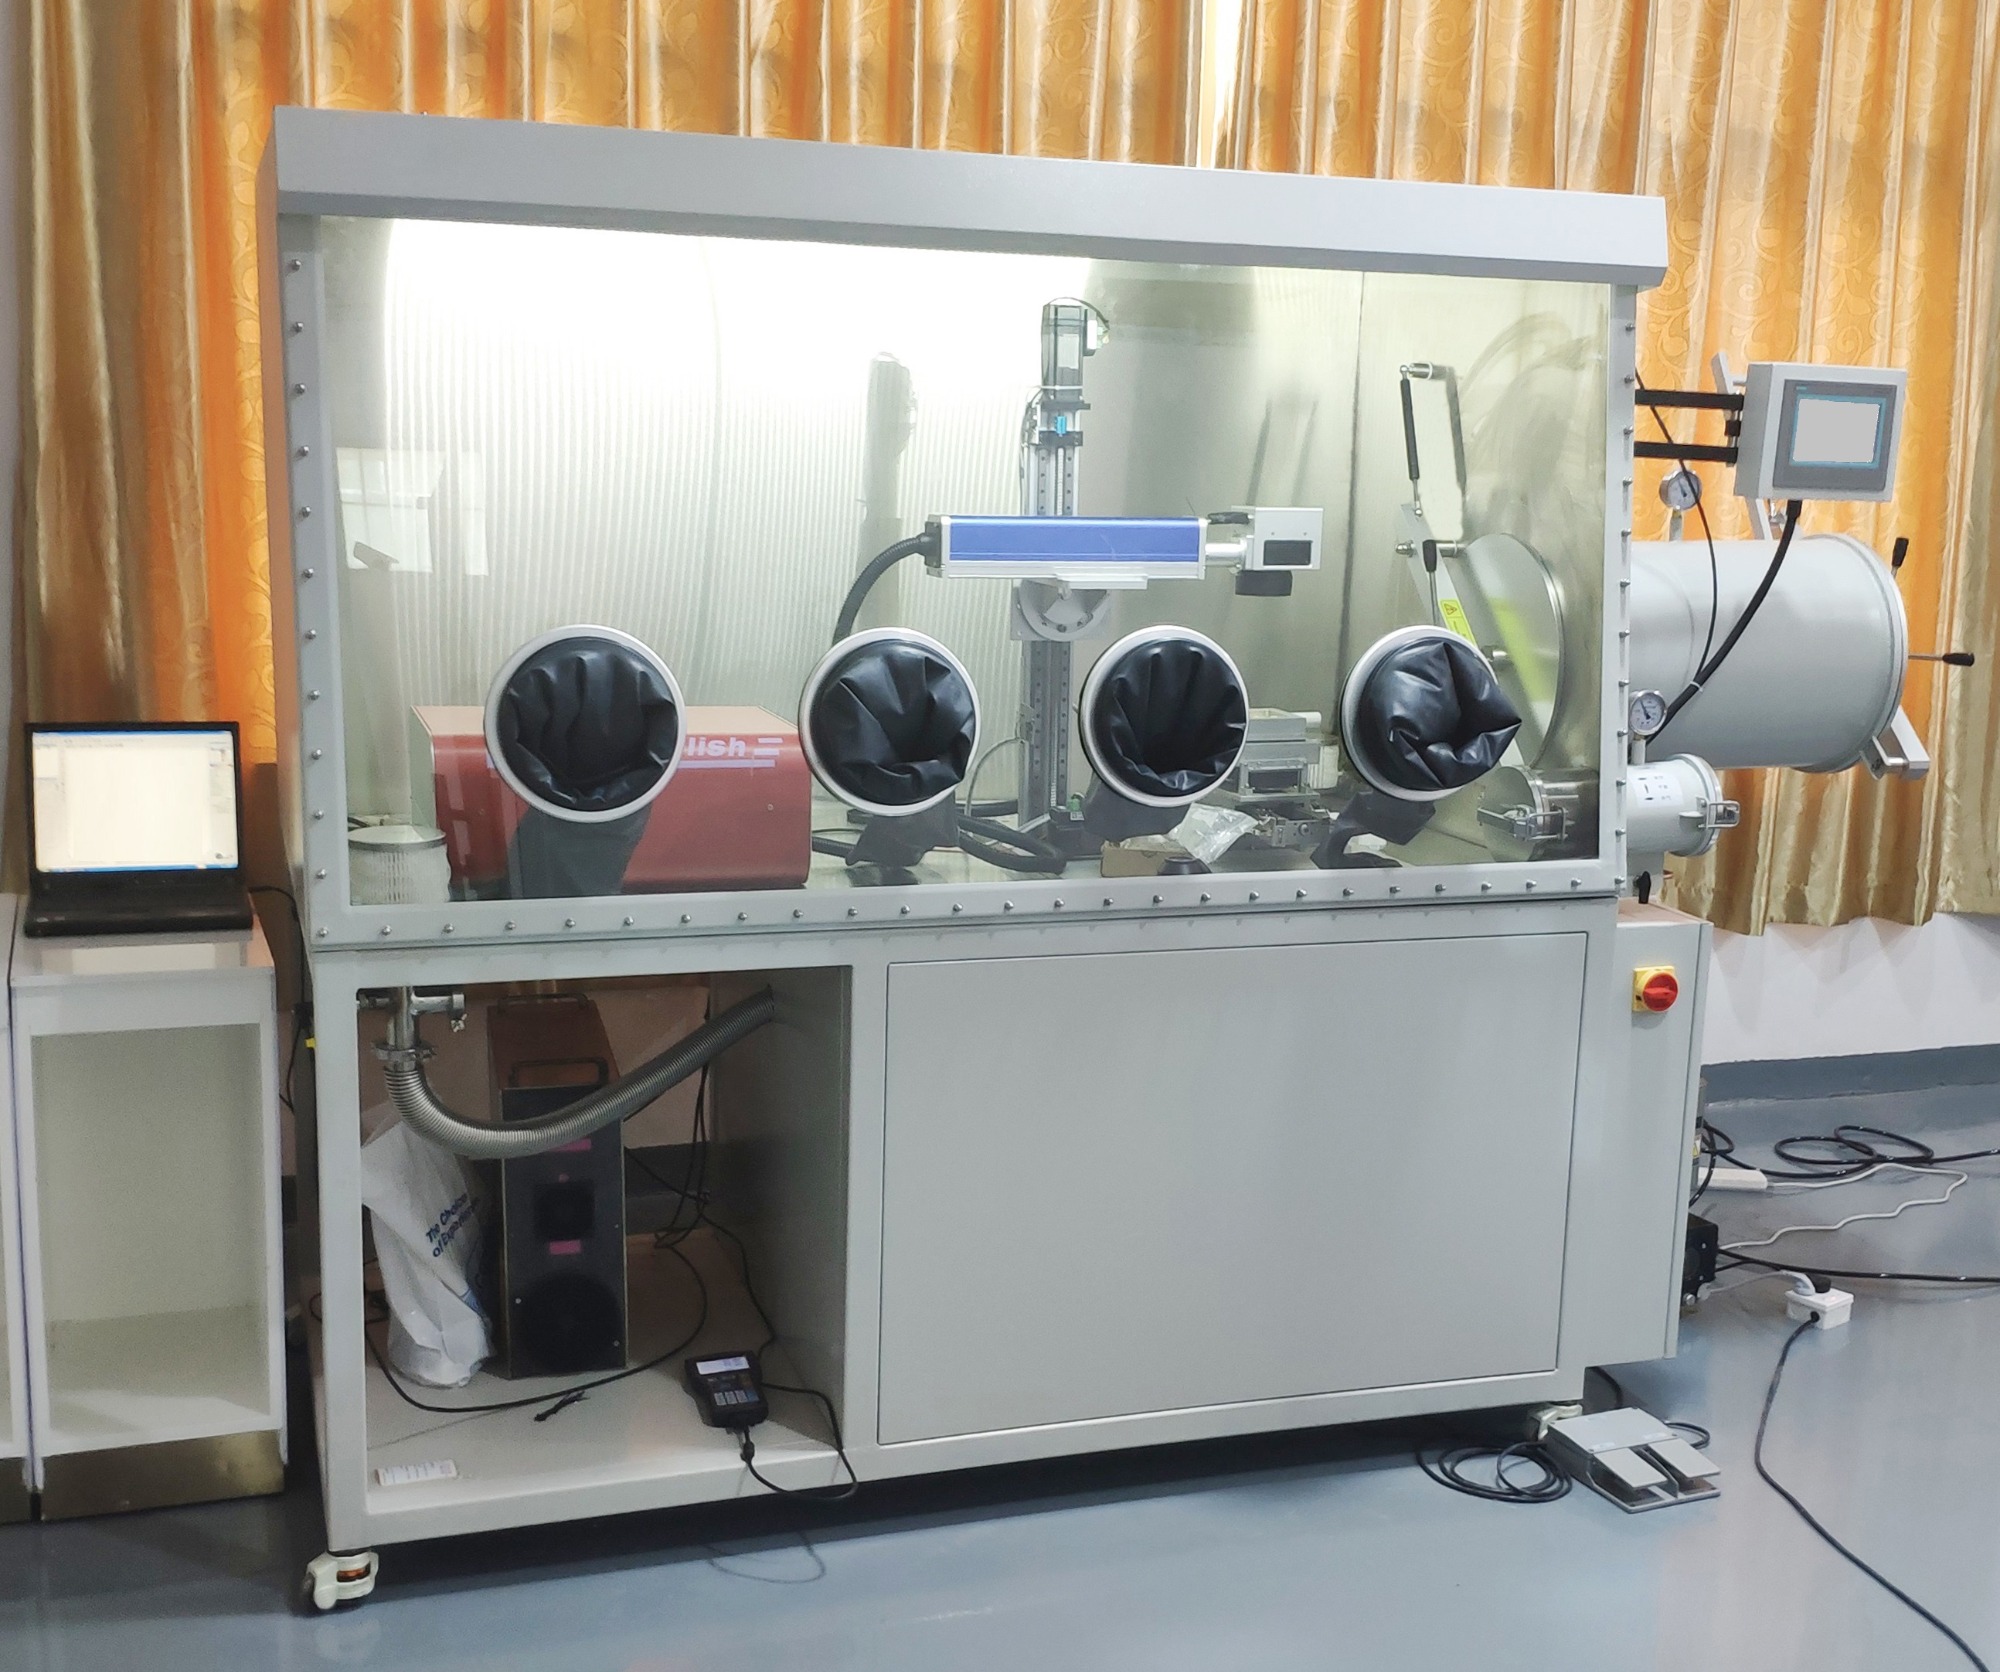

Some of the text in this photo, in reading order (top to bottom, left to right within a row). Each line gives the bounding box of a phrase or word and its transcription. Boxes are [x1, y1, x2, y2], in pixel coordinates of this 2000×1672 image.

[686, 736, 747, 757] lish
[425, 1223, 441, 1244] The
[432, 1239, 445, 1258] of
